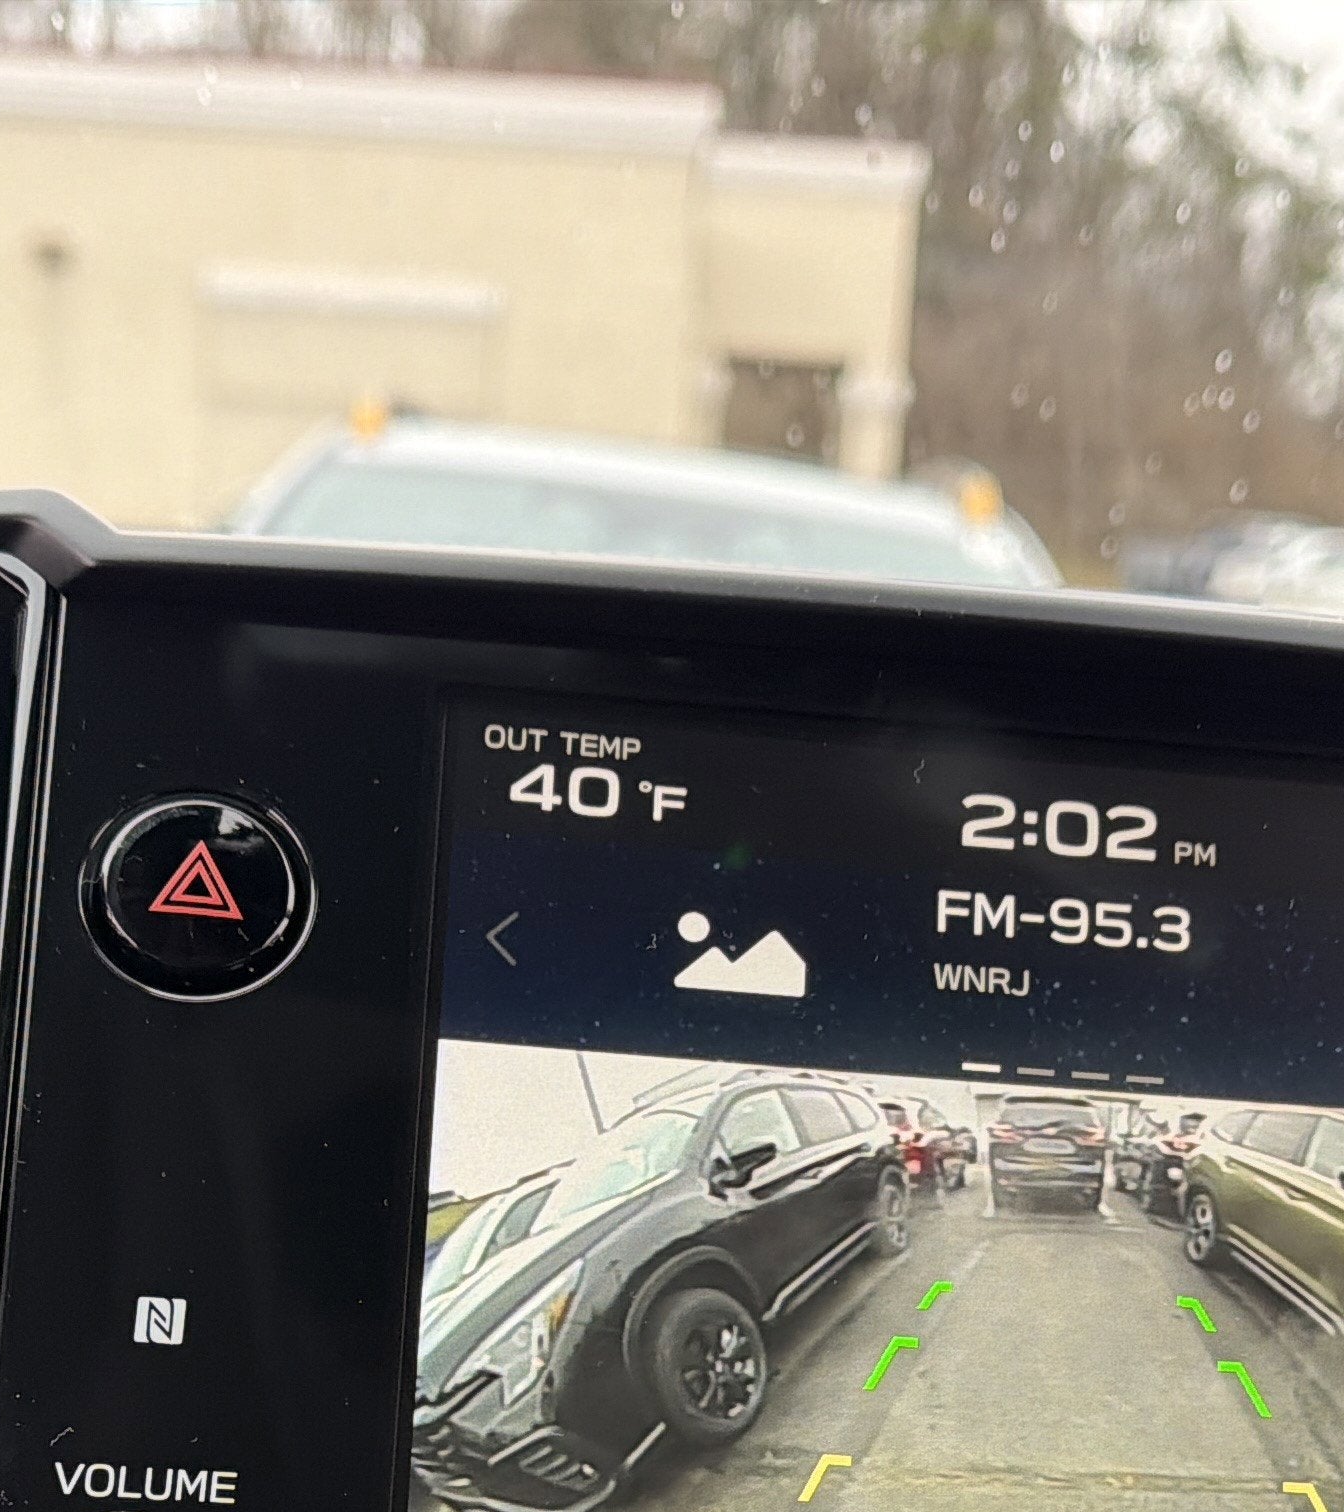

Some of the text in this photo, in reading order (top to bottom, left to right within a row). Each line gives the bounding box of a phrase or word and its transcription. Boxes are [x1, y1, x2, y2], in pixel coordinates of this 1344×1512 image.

[484, 724, 642, 760] OUT TEMP
[509, 764, 620, 818] 40
[961, 794, 1218, 867] 2:02 PM
[936, 890, 1192, 952] FM-95.3
[934, 963, 1031, 996] WNRJ
[55, 1461, 238, 1504] VOLUME
